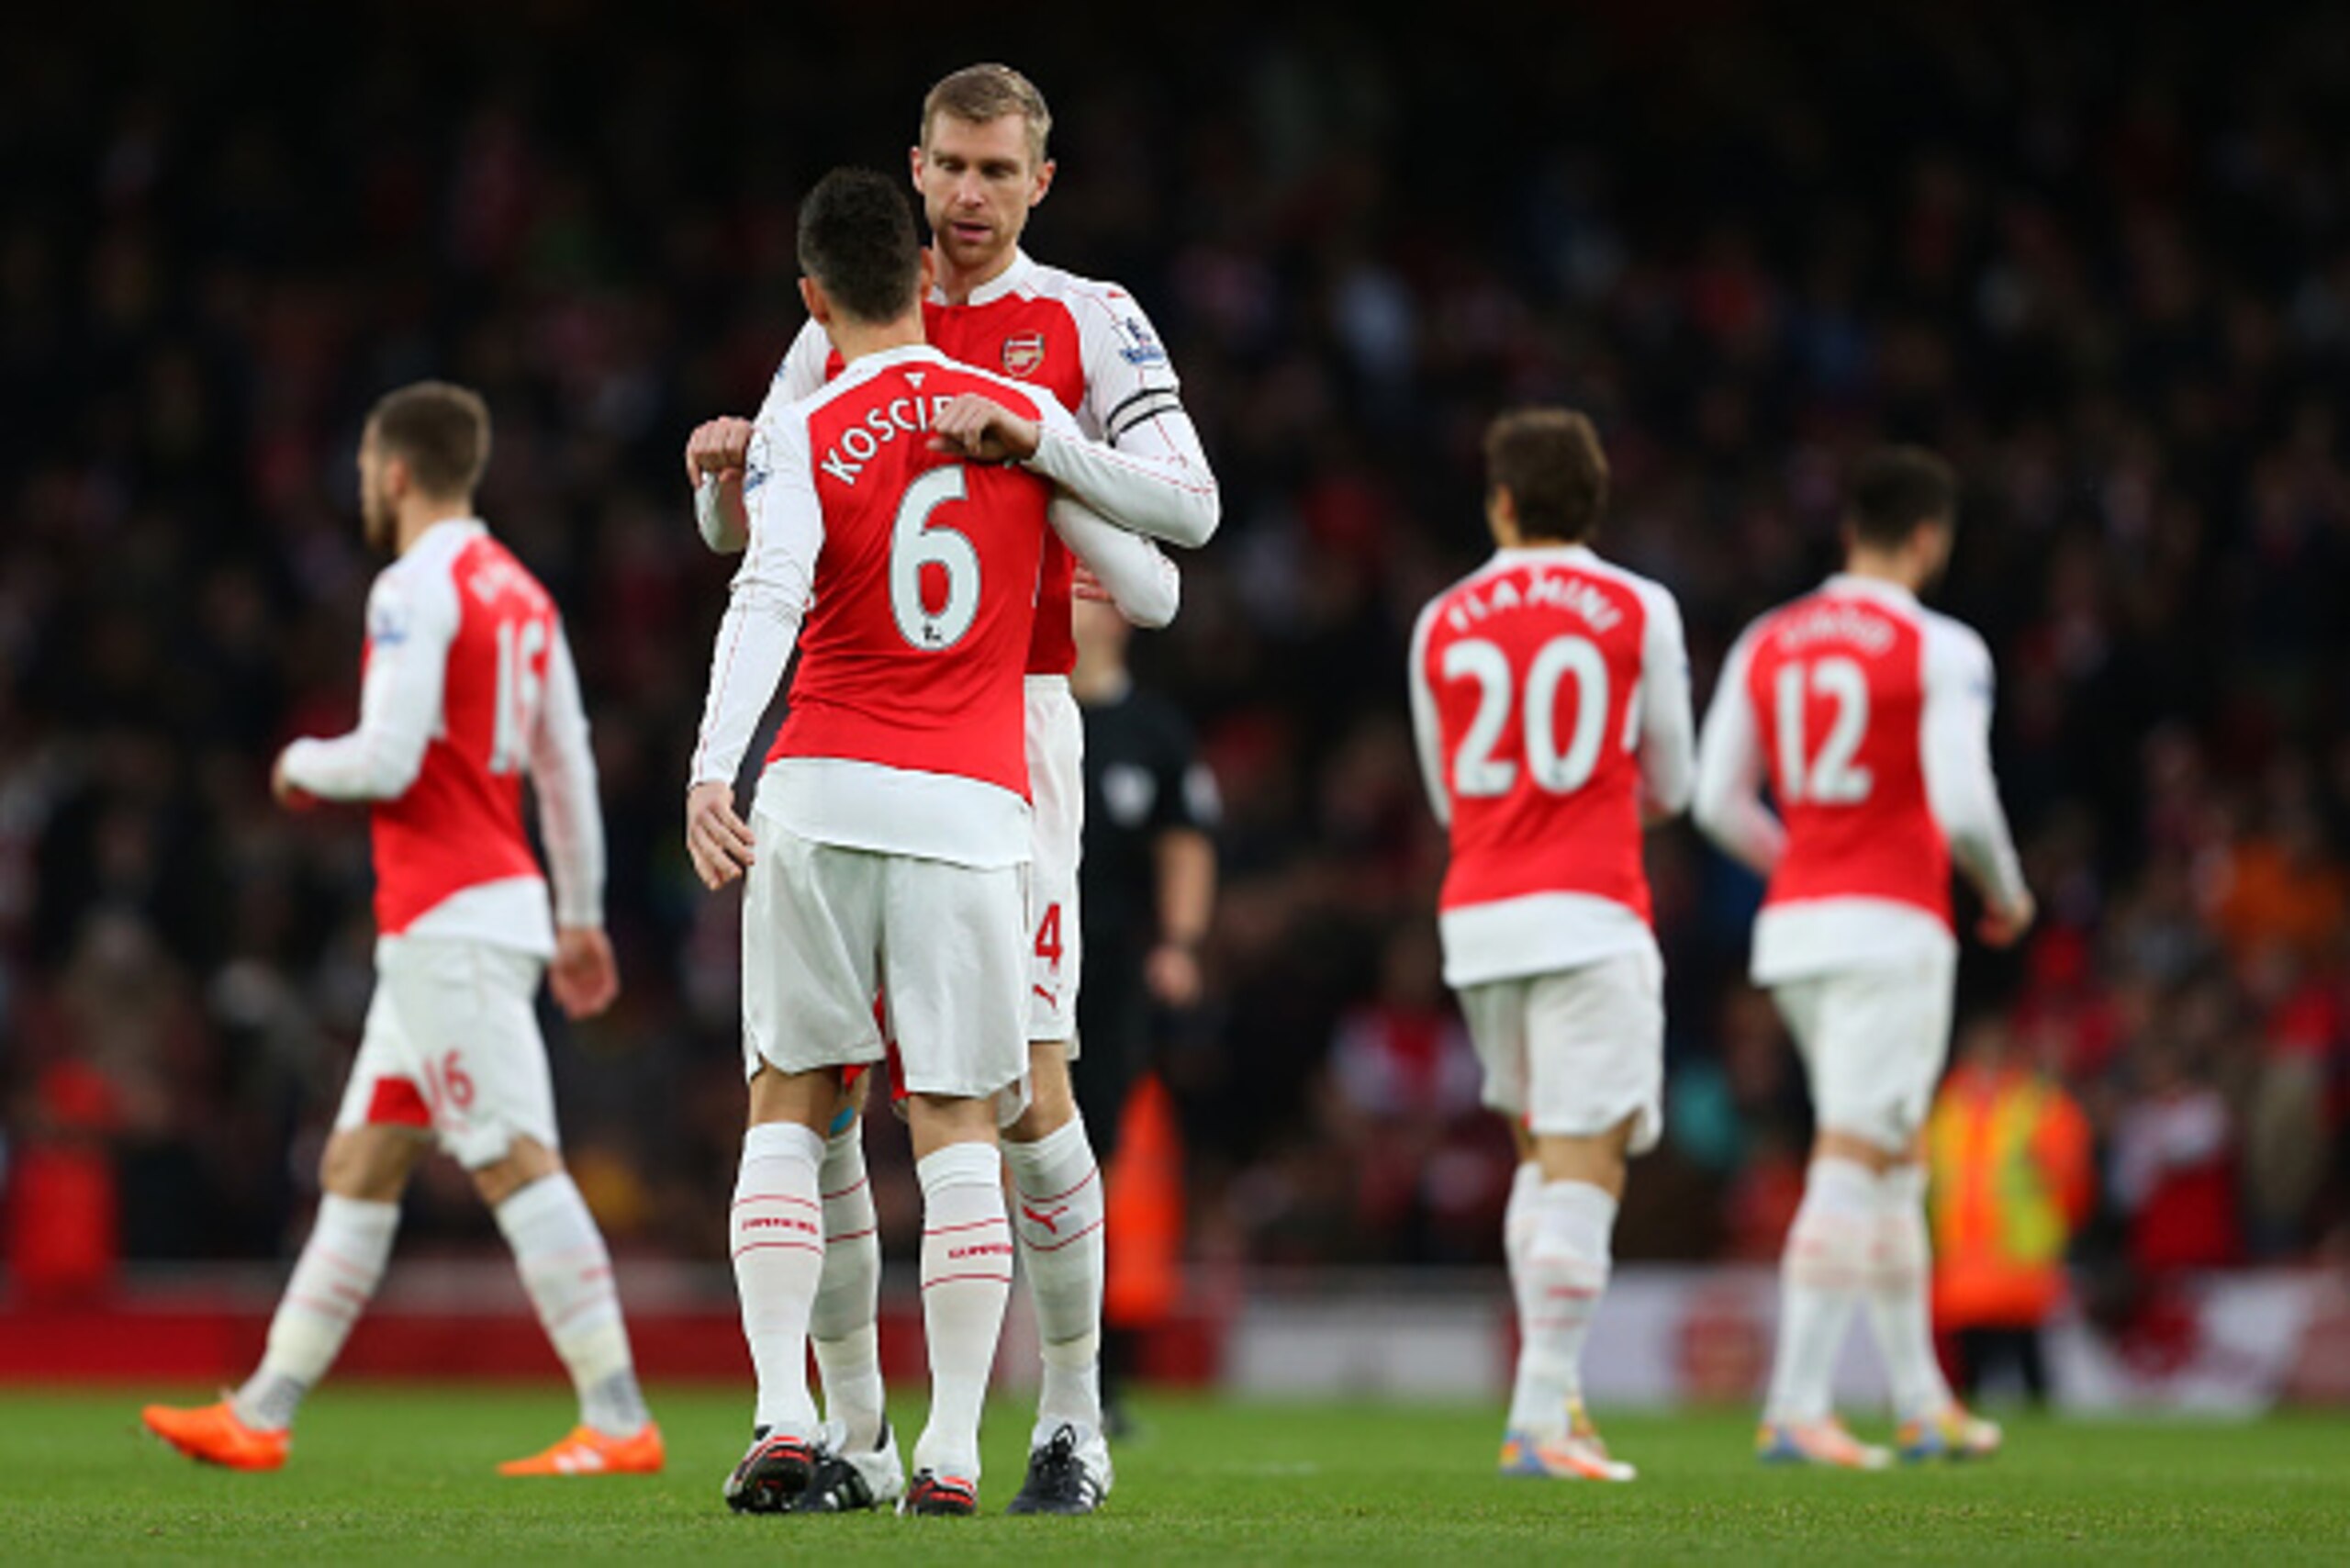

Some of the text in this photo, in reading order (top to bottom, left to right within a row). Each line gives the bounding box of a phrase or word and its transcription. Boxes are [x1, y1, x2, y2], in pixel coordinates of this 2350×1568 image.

[889, 463, 981, 651] 6
[1442, 634, 1608, 796] 20
[1774, 655, 1873, 805] 12
[1035, 901, 1063, 975] 4
